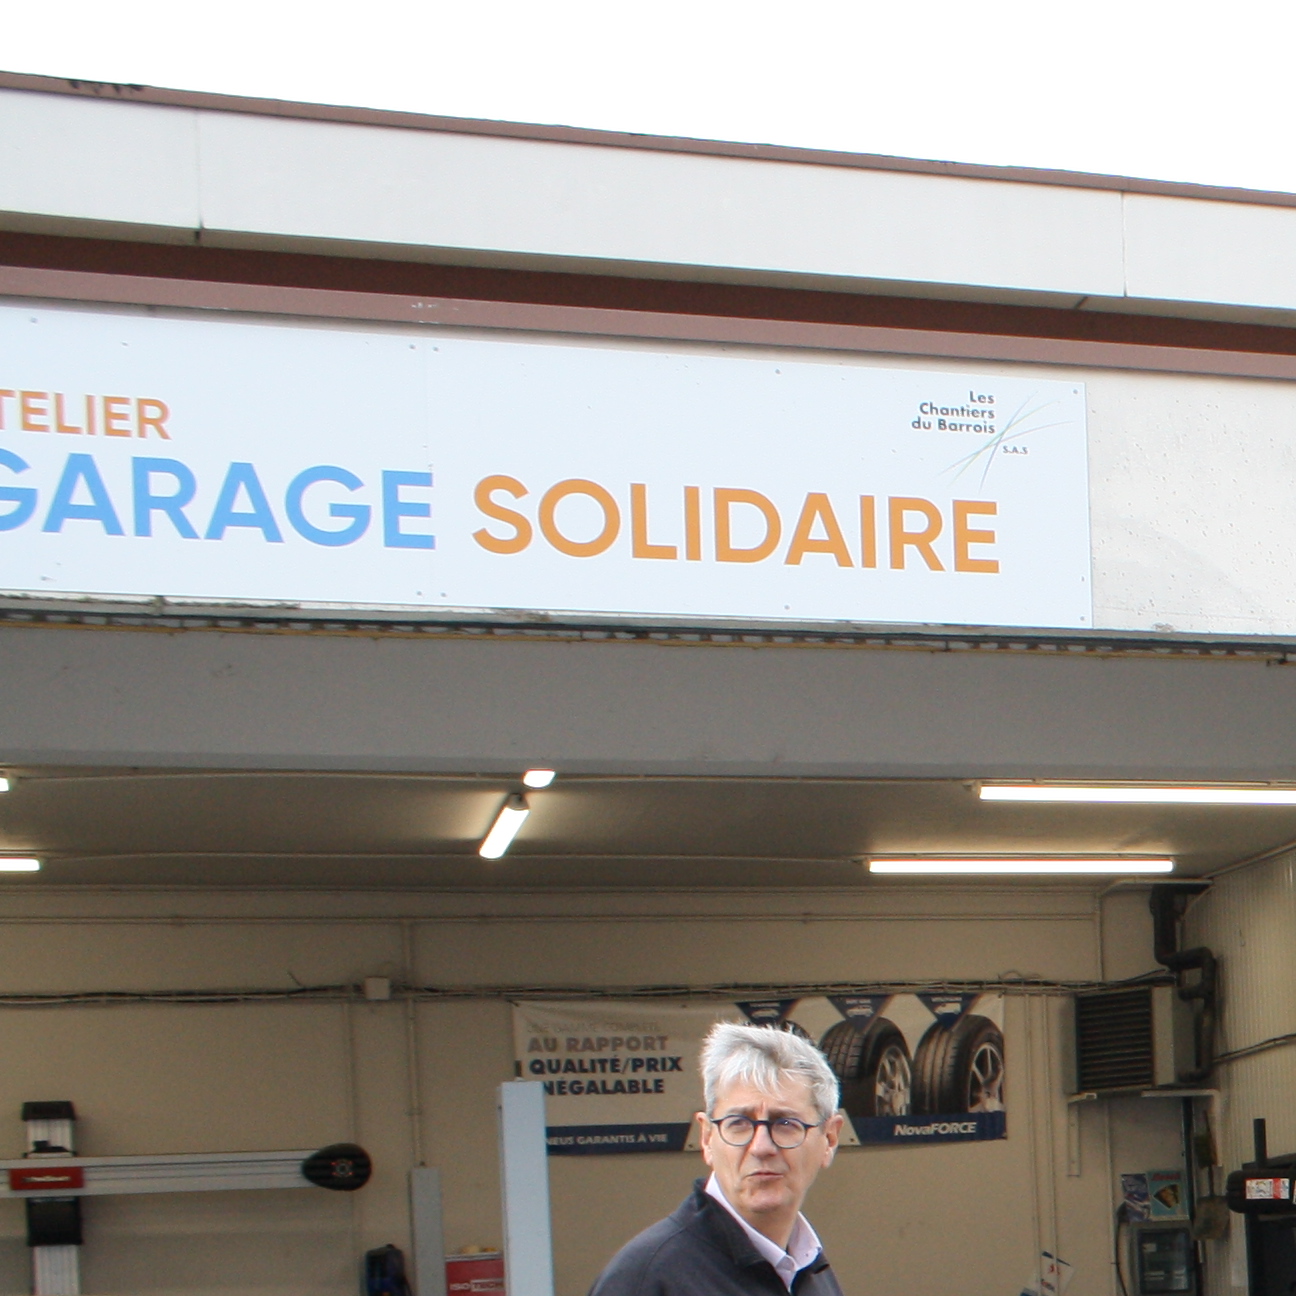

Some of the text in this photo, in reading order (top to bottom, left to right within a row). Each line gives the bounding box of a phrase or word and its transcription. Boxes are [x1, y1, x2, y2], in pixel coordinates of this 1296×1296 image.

[969, 390, 995, 404] Les
[0, 389, 172, 440] TELIER
[919, 401, 995, 419] Chantiers
[911, 416, 996, 434] du Barrois
[471, 473, 1000, 574] SOLIDAIRE
[527, 1035, 669, 1053] AU RAPPORT
[529, 1055, 683, 1075] QUALITÉ/PRIX
[543, 1078, 665, 1096] NÉGALABLE
[894, 1121, 977, 1137] NovaFORCE
[546, 1132, 668, 1146] NEUS GARANTIS À VIE
